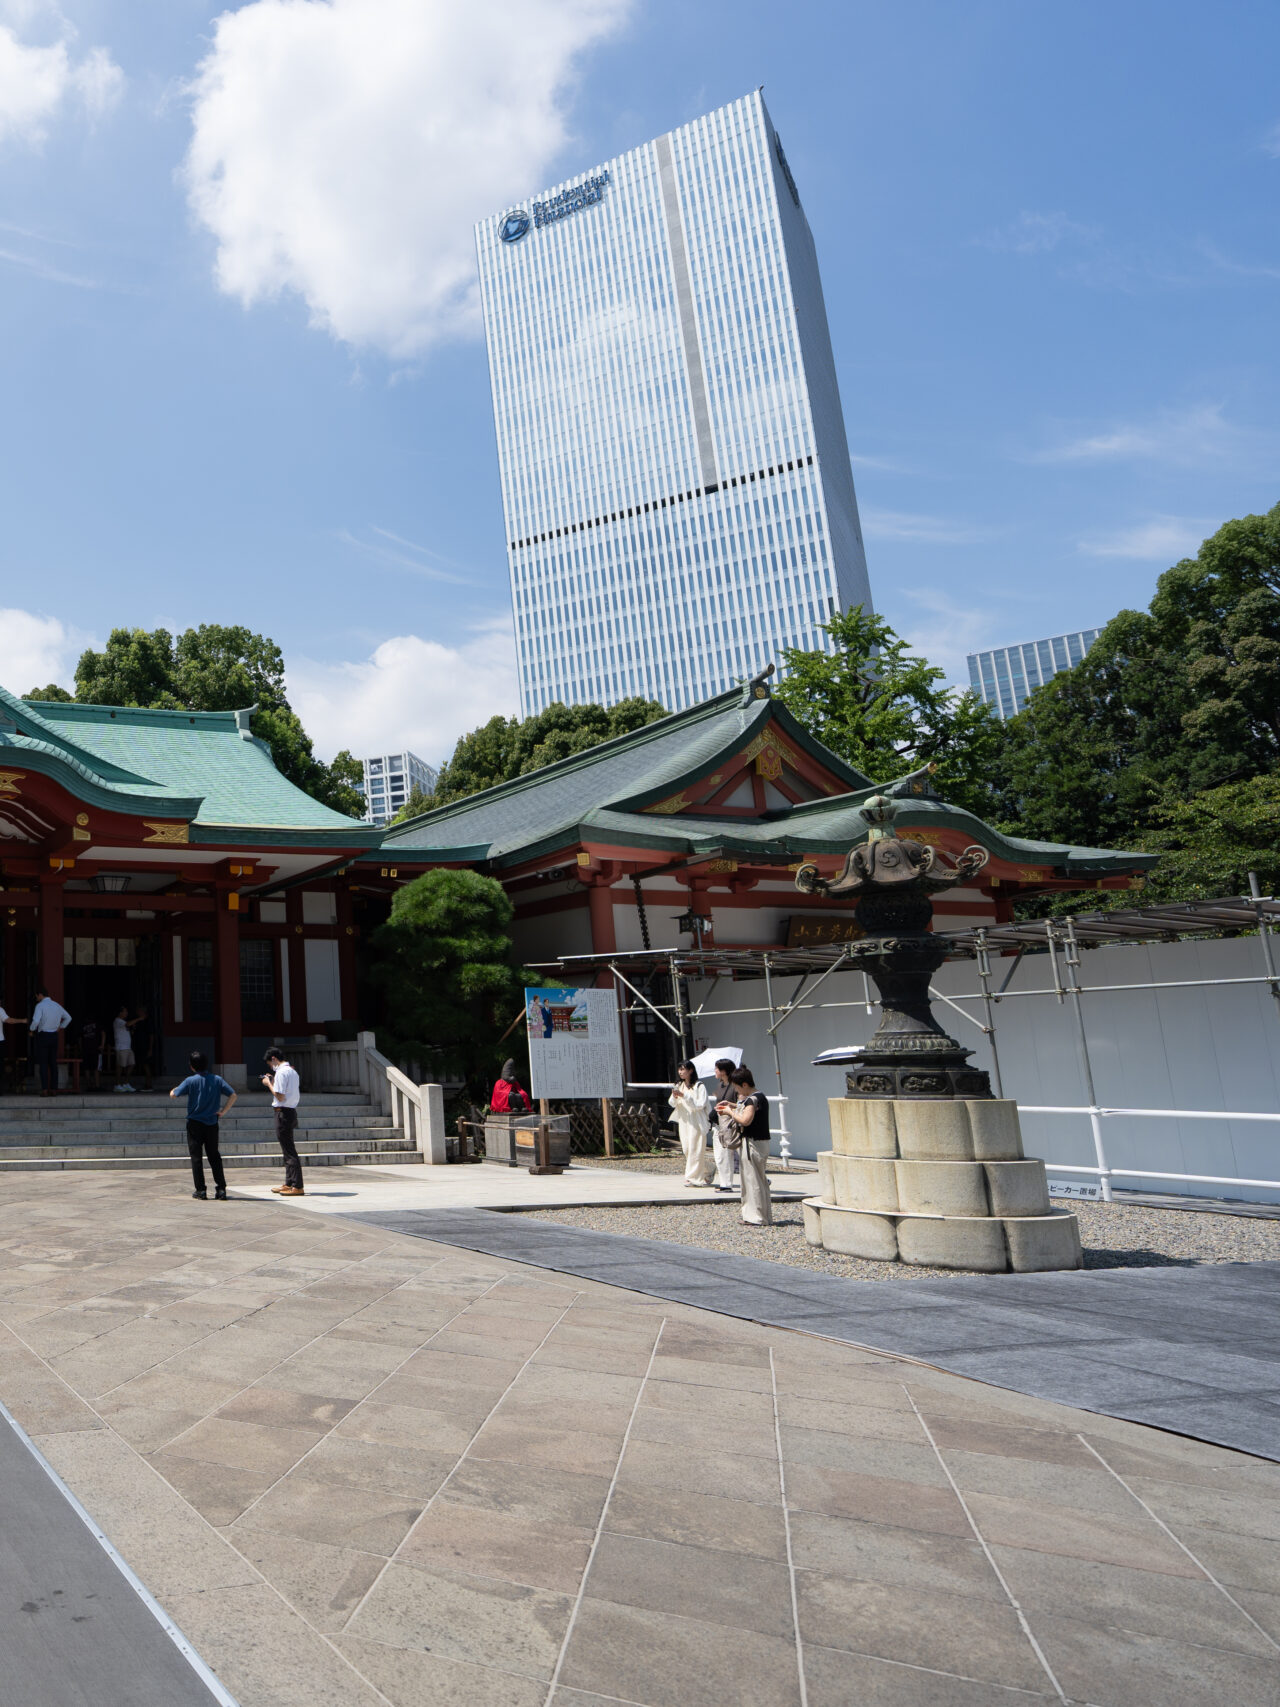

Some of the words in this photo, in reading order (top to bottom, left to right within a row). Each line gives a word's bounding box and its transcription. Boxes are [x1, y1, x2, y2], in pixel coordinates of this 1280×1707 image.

[532, 170, 609, 214] Prudential
[534, 188, 602, 228] Financial
[1048, 1184, 1097, 1196] ビーカー置場
